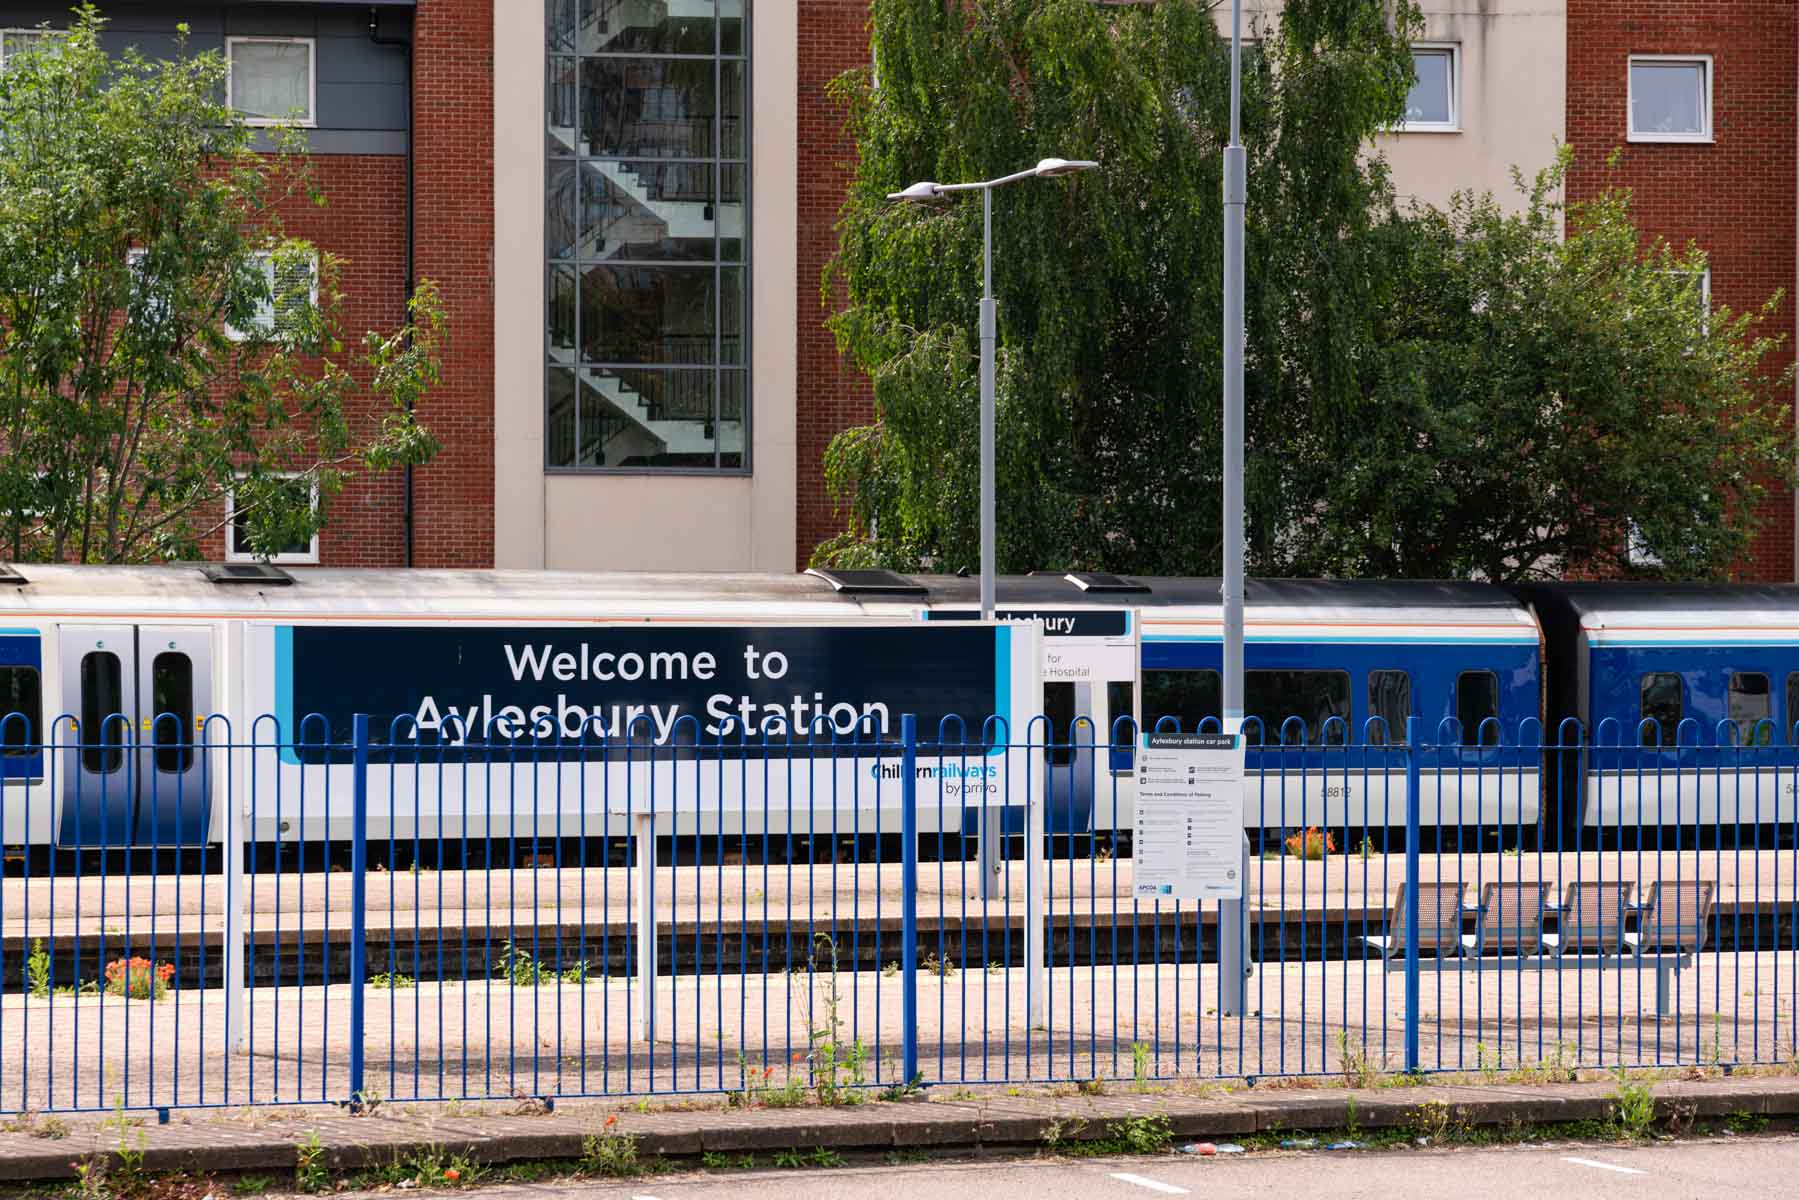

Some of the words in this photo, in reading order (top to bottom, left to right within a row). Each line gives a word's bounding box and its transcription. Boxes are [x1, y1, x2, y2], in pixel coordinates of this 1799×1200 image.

[504, 643, 717, 681] Welcome
[744, 645, 788, 681] to
[1048, 653, 1062, 663] for
[1050, 666, 1090, 679] Hospital
[408, 694, 680, 746] Aylesbury
[705, 692, 890, 737] Station
[1151, 737, 1182, 746] Aylesbury
[1183, 737, 1205, 745] station
[1217, 738, 1231, 747] park
[870, 762, 997, 781] Chilrnrailways
[945, 782, 961, 796] by
